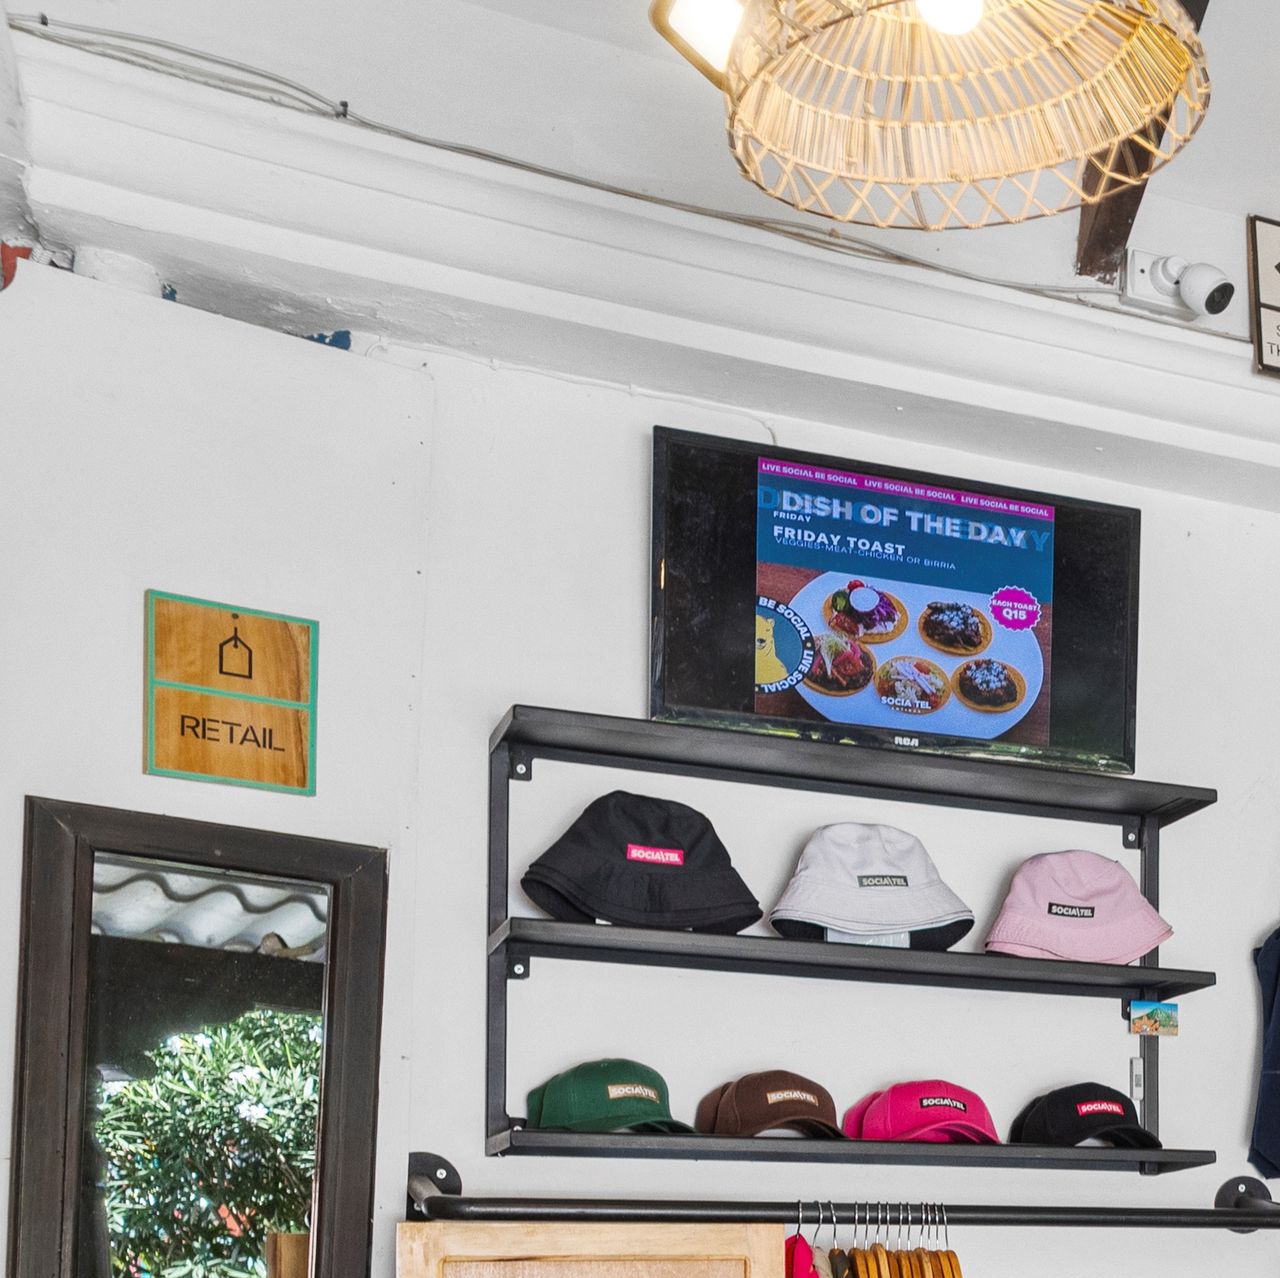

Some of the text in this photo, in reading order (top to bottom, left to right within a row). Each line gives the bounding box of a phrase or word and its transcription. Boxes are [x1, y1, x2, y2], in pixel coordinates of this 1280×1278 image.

[762, 463, 1049, 517] LIVE SOCIAL BE SOCIAL LIVE SOCIAL BE SOCIAL LIVE SOCIAL BE SOCIAL
[773, 511, 811, 523] FRIDAY
[782, 490, 1027, 547] DISH OF THE DAY
[773, 526, 905, 556] FRIDAY TOAST
[906, 556, 956, 570] OR BIRRIA
[992, 599, 1037, 611] EACH TOAST
[1002, 608, 1027, 620] Q15
[759, 596, 810, 641] BE SOCIAL
[764, 672, 803, 694] SOCIAL
[180, 714, 285, 752] RETAIL
[894, 736, 919, 747] RCA
